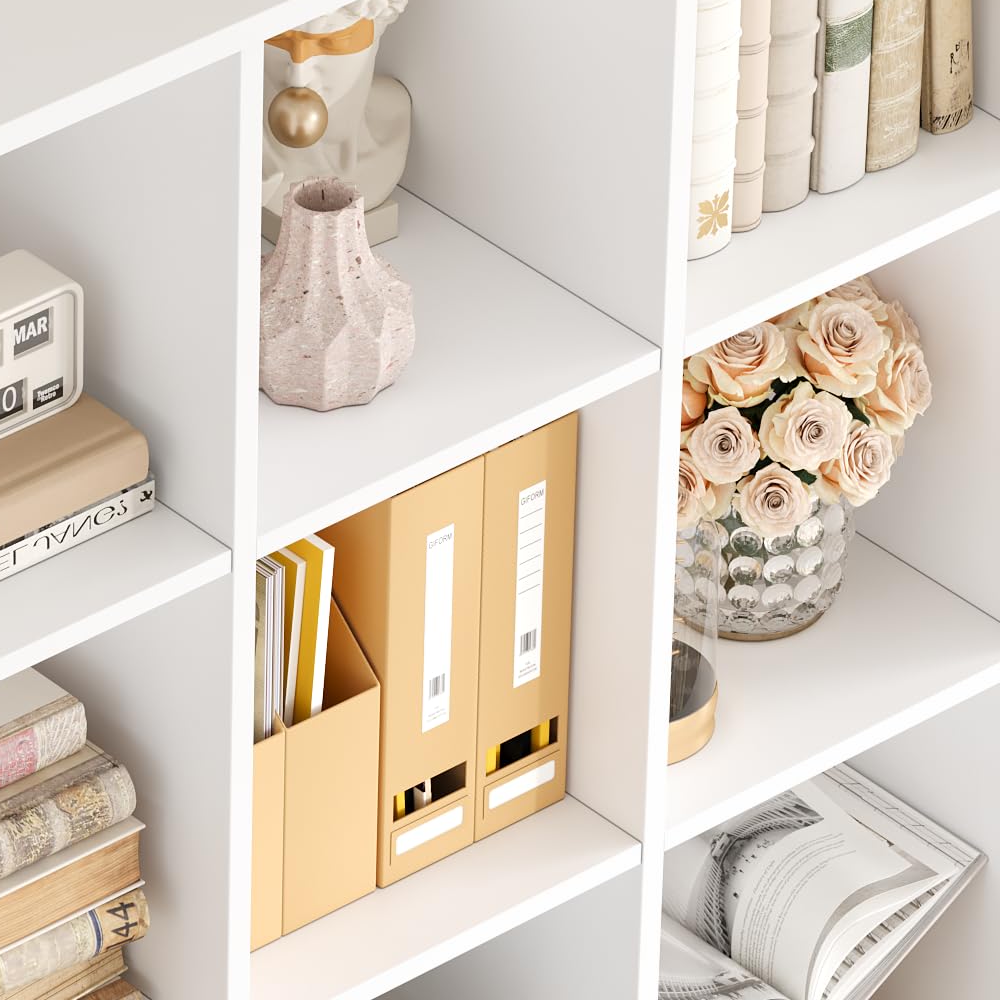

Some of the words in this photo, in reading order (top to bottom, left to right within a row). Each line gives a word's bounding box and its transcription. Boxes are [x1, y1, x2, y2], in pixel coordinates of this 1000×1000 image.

[13, 316, 48, 345] MAR
[520, 488, 544, 506] GIFORM
[428, 532, 453, 549] GIFORM
